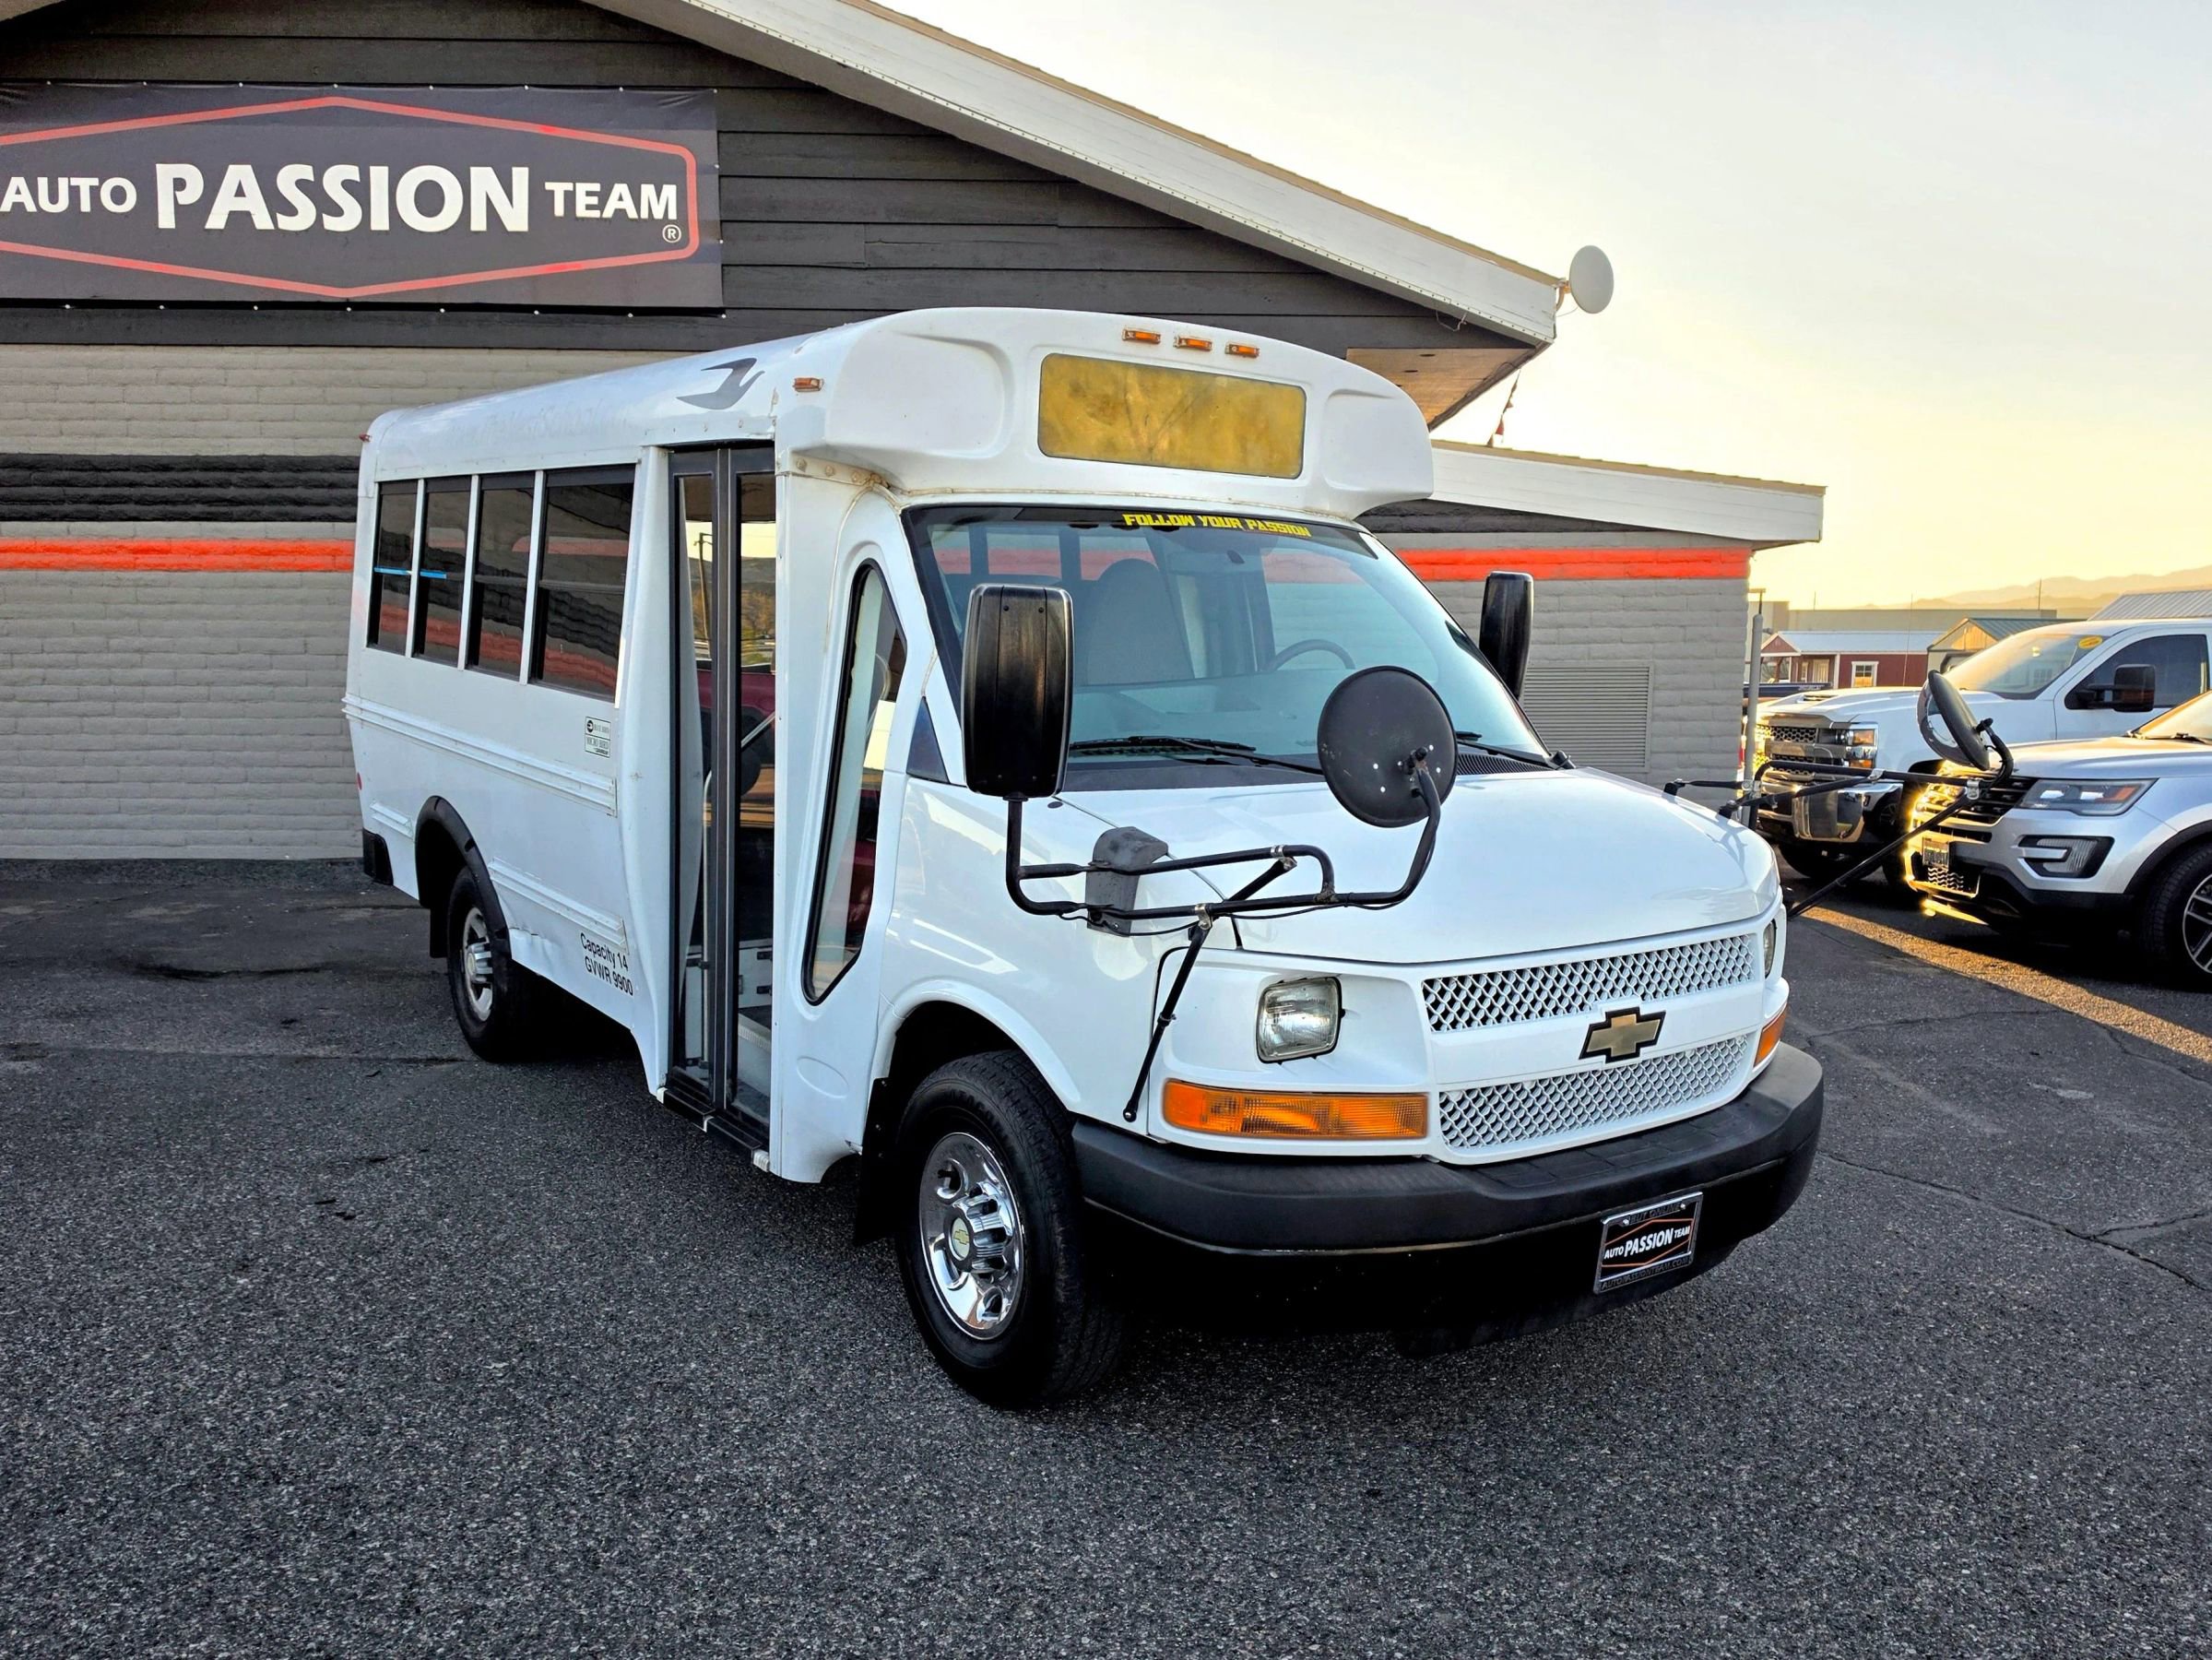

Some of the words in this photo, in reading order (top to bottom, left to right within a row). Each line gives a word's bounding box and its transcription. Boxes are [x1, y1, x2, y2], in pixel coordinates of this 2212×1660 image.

[1, 175, 137, 213] AUTO
[156, 162, 529, 232] PASSION
[544, 182, 678, 220] TEAM
[1121, 513, 1196, 527] FOLLOW
[1197, 515, 1245, 531] YOUR
[1245, 519, 1312, 538] PASSION
[580, 932, 616, 968] Capacity
[617, 952, 629, 971] 14
[585, 955, 611, 984] GVWR
[612, 970, 633, 996] 9900
[1603, 1246, 1625, 1260] AUTO
[1624, 1227, 1674, 1257] PASSION
[1674, 1226, 1691, 1239] TEAM
